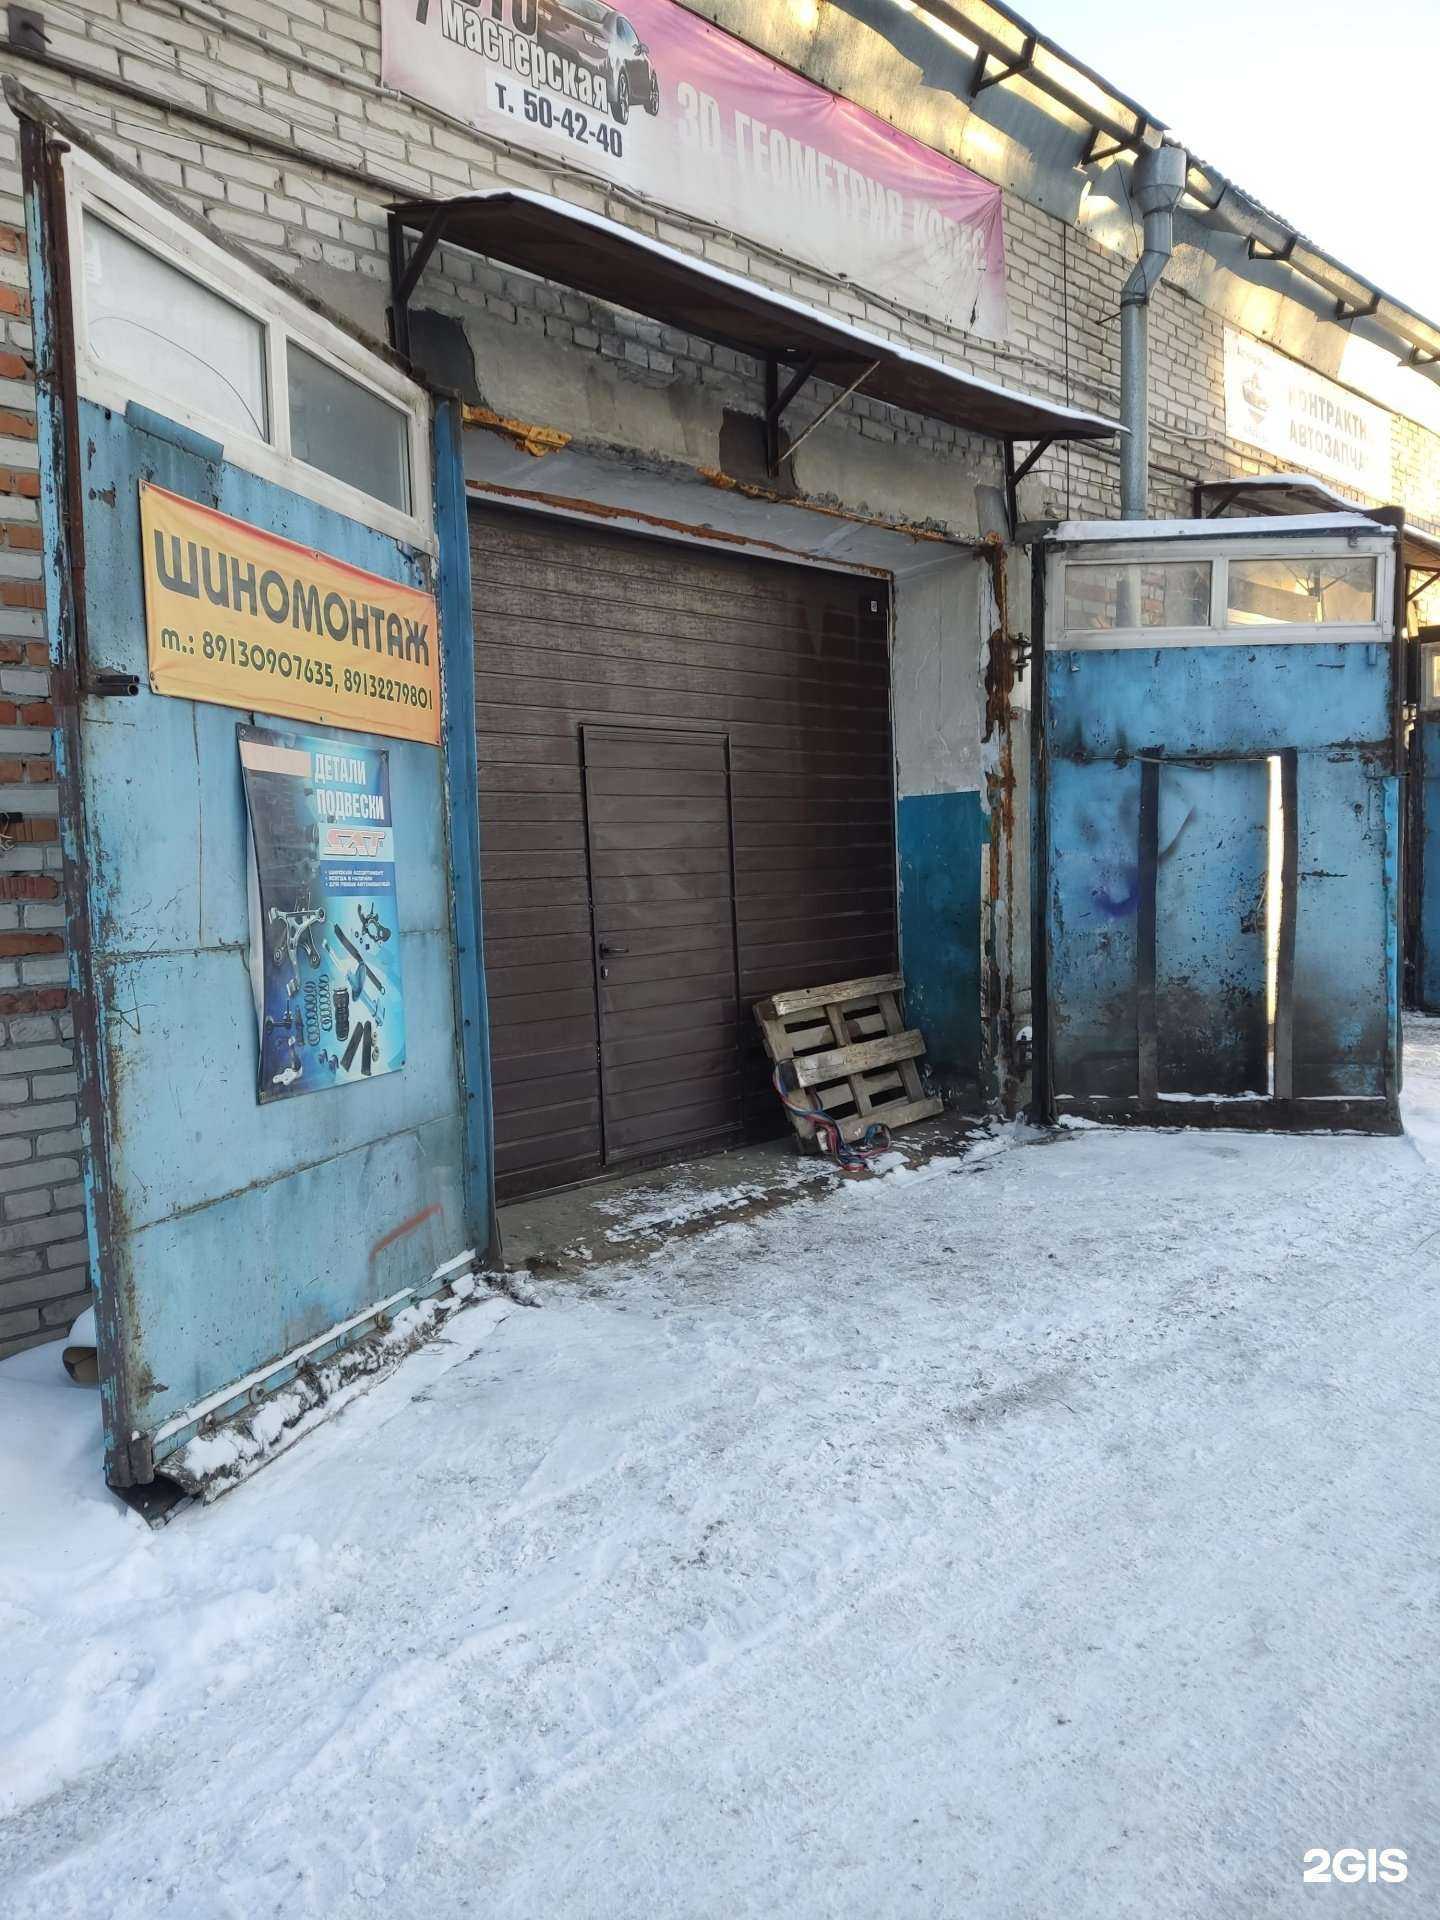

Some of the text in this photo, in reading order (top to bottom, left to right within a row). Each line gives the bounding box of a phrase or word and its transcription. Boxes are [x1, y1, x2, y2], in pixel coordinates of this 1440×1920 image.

[523, 88, 623, 158] 50-42-40
[735, 110, 903, 240] ГЕОМЕТРИЯ
[153, 528, 430, 667] ШИНОМОНТАЖ
[202, 631, 339, 694] 89130907635,
[343, 668, 434, 711] 89132279801
[314, 752, 367, 785] ДЕТАЛИ
[316, 788, 386, 821] ПОДВЕСКИ
